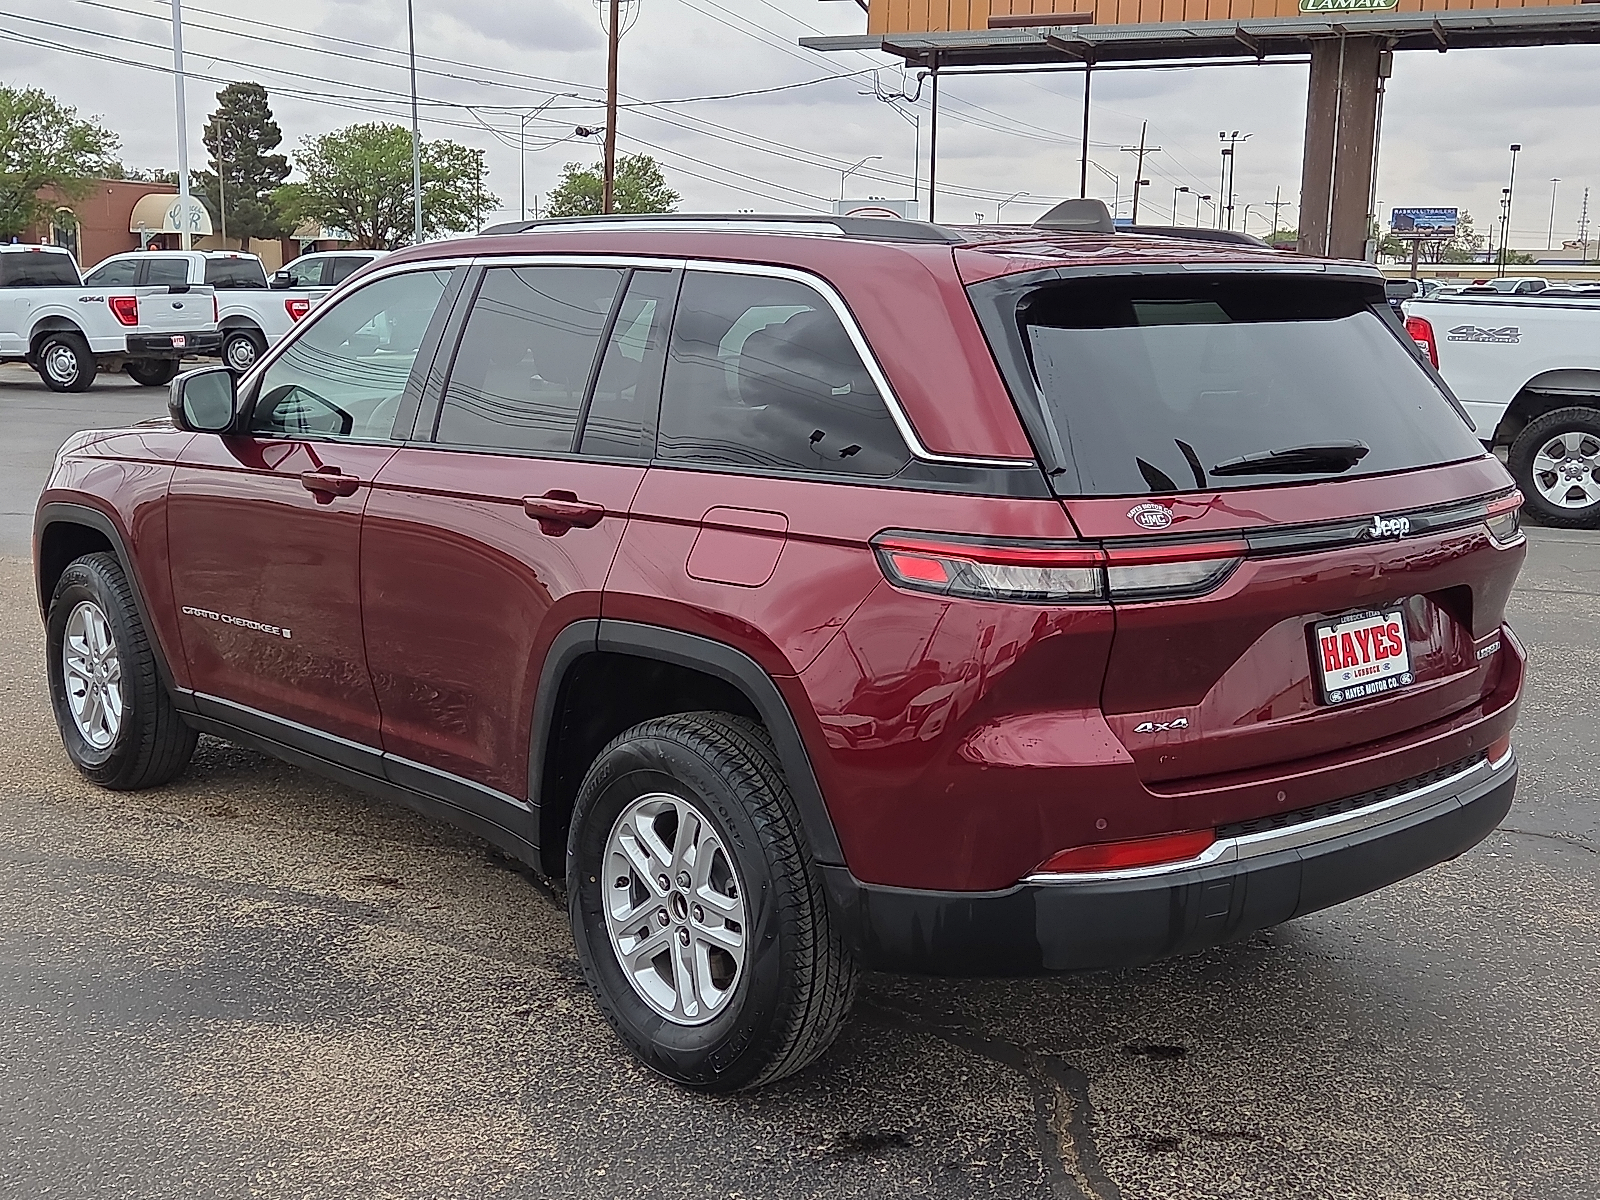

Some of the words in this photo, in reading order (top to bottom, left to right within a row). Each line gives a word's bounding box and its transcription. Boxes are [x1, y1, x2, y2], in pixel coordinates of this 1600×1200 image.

[1306, 0, 1387, 10] LAMAR
[1140, 512, 1167, 526] HMC
[1369, 515, 1410, 540] Jeep
[182, 606, 219, 621] GRAND
[221, 614, 281, 636] CHEROKEE
[1321, 622, 1403, 673] HAYES
[1353, 664, 1381, 679] LUBBOCK
[1344, 687, 1365, 700] HAYES
[1365, 680, 1388, 695] MOTOR
